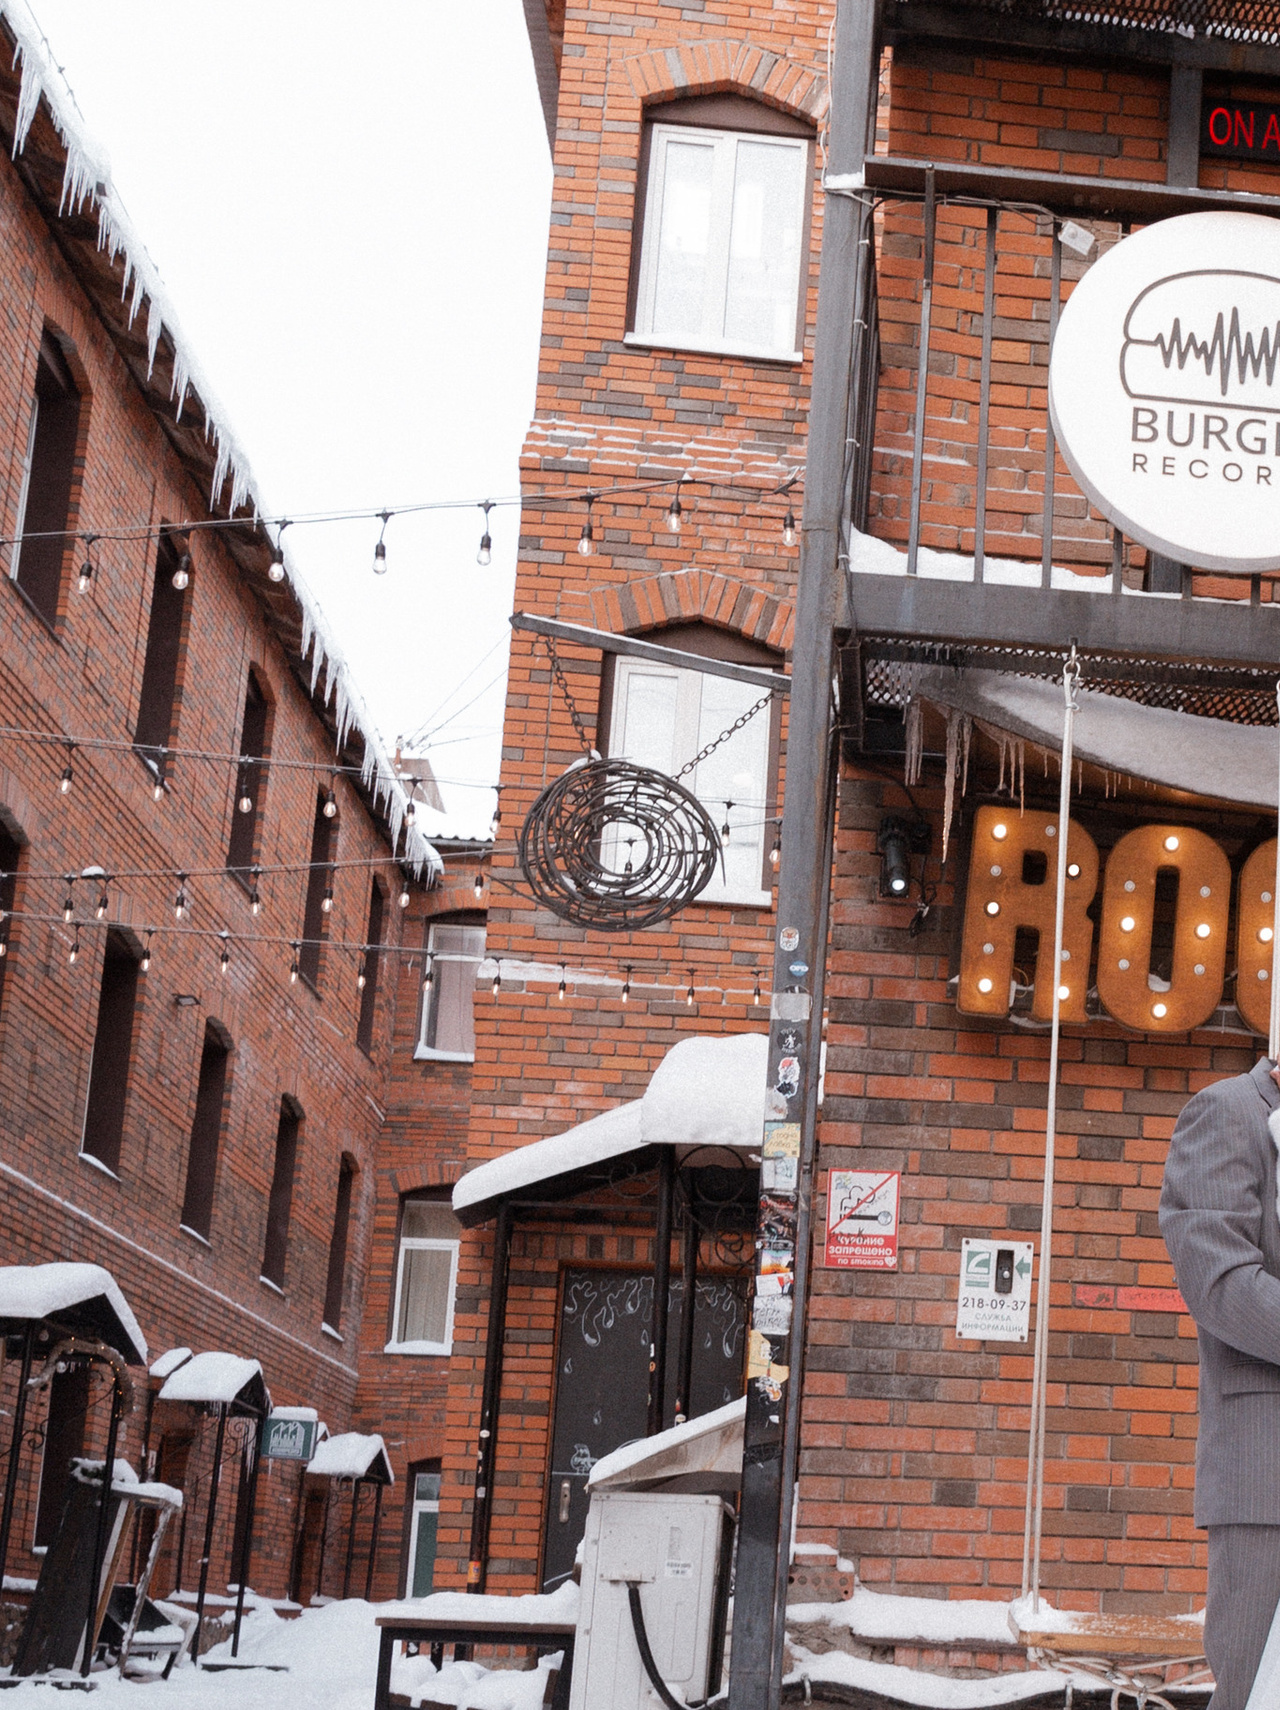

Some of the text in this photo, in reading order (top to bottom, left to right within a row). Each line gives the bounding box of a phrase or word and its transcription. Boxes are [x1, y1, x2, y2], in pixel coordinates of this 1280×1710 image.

[1208, 107, 1254, 148] ON
[962, 1296, 1027, 1311] 218-09-37
[974, 1312, 1012, 1322] СЛУЖБА
[961, 1322, 1024, 1332] ИНФОРМАЦИИ
